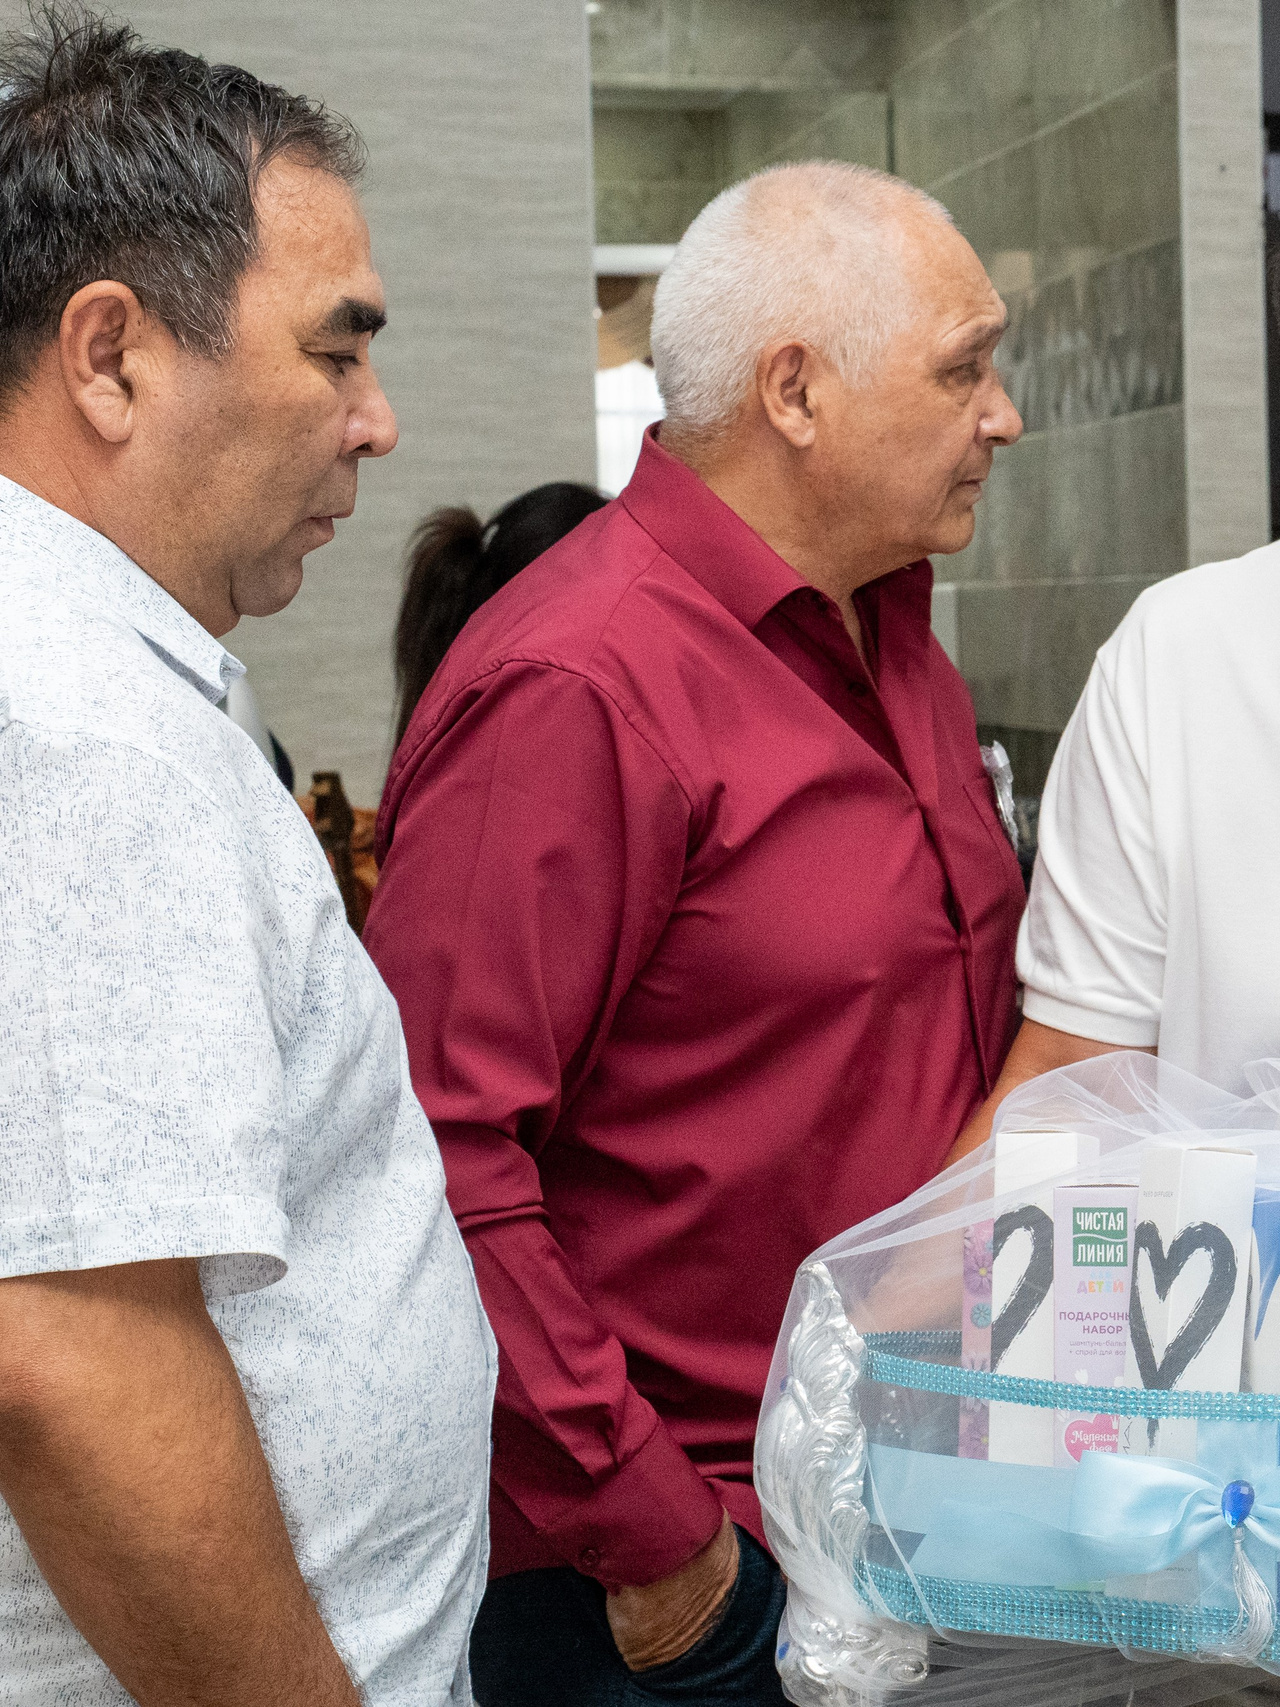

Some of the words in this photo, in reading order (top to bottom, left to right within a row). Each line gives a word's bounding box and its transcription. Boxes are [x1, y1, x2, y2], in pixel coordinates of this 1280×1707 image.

[1076, 1212, 1124, 1231] ЧИСТАЯ
[1077, 1244, 1124, 1263] ЛИНИЯ
[1060, 1311, 1130, 1322] ПОДАРОЧНЫ
[1082, 1325, 1123, 1335] НАБОР
[1070, 1430, 1119, 1444] Маленьк
